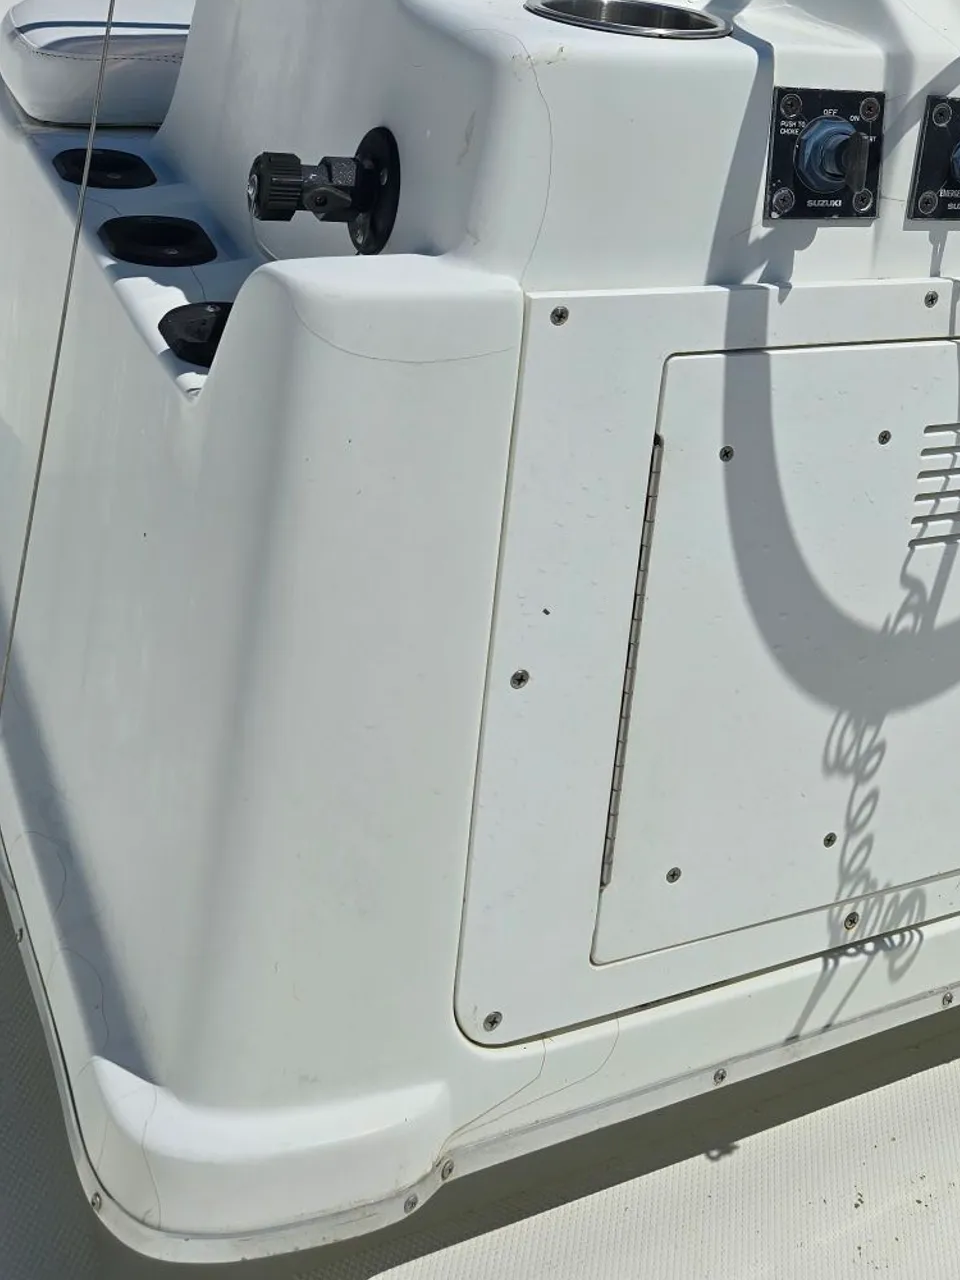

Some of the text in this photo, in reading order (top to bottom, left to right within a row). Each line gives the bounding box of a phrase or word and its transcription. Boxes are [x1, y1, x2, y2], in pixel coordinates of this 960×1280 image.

[823, 108, 838, 116] OFF
[780, 120, 796, 128] PUSH
[806, 200, 842, 208] SUZUKI
